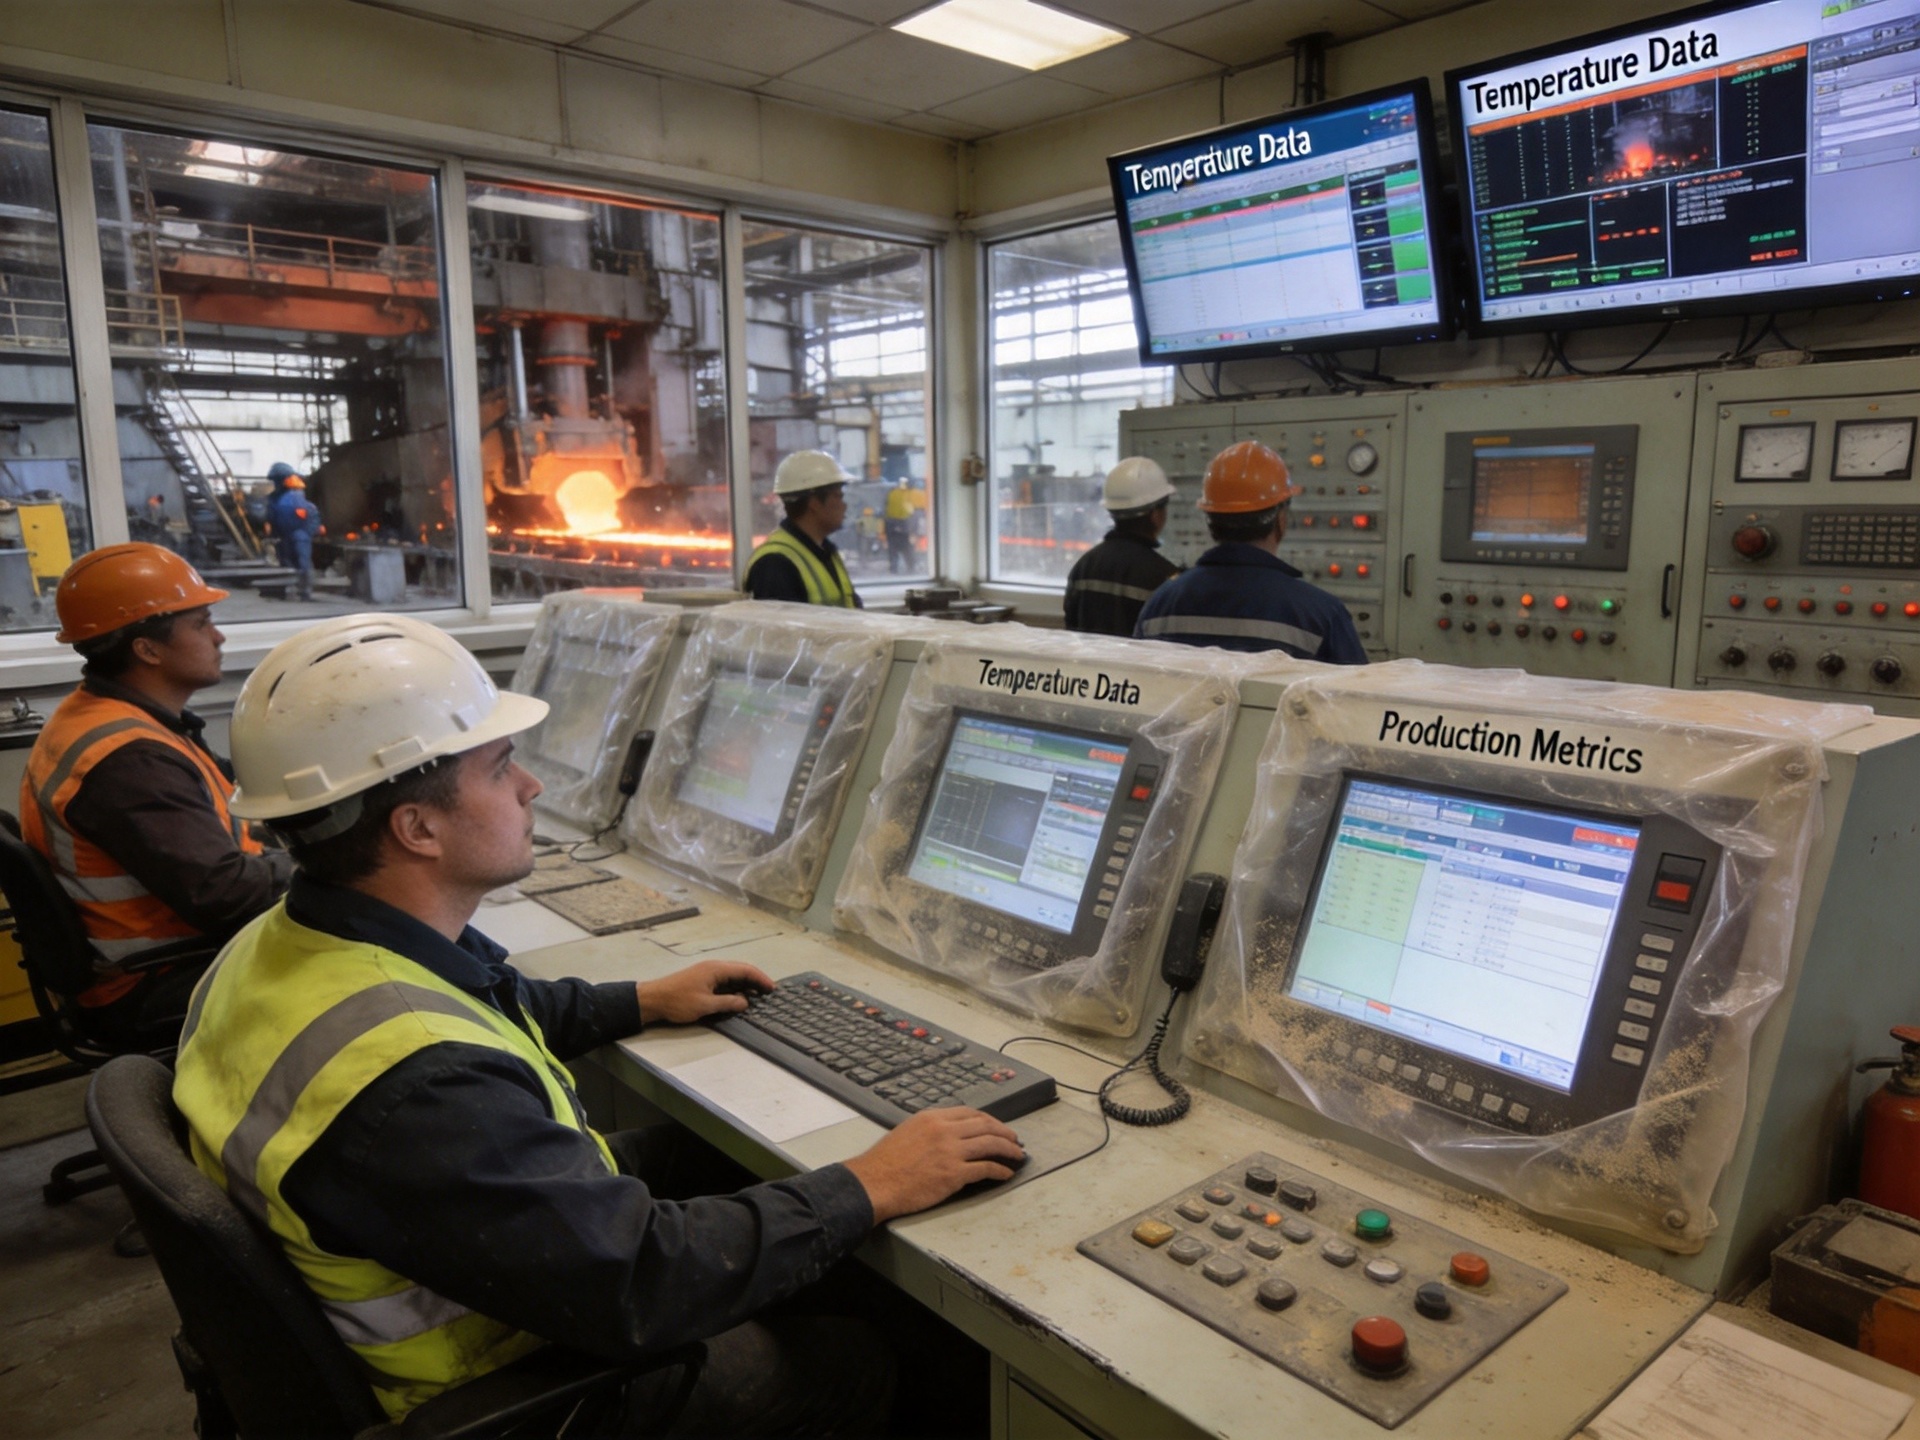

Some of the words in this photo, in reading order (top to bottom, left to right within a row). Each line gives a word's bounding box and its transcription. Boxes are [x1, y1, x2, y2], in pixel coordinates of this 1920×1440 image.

[1467, 48, 1639, 112] Temperature
[1648, 30, 1719, 73] Data
[1125, 141, 1253, 193] Temperature
[1258, 127, 1312, 164] Data
[979, 659, 1089, 697] Temperature
[1094, 673, 1140, 705] Data
[1379, 711, 1521, 758] Production
[1530, 728, 1643, 773] Metrics
